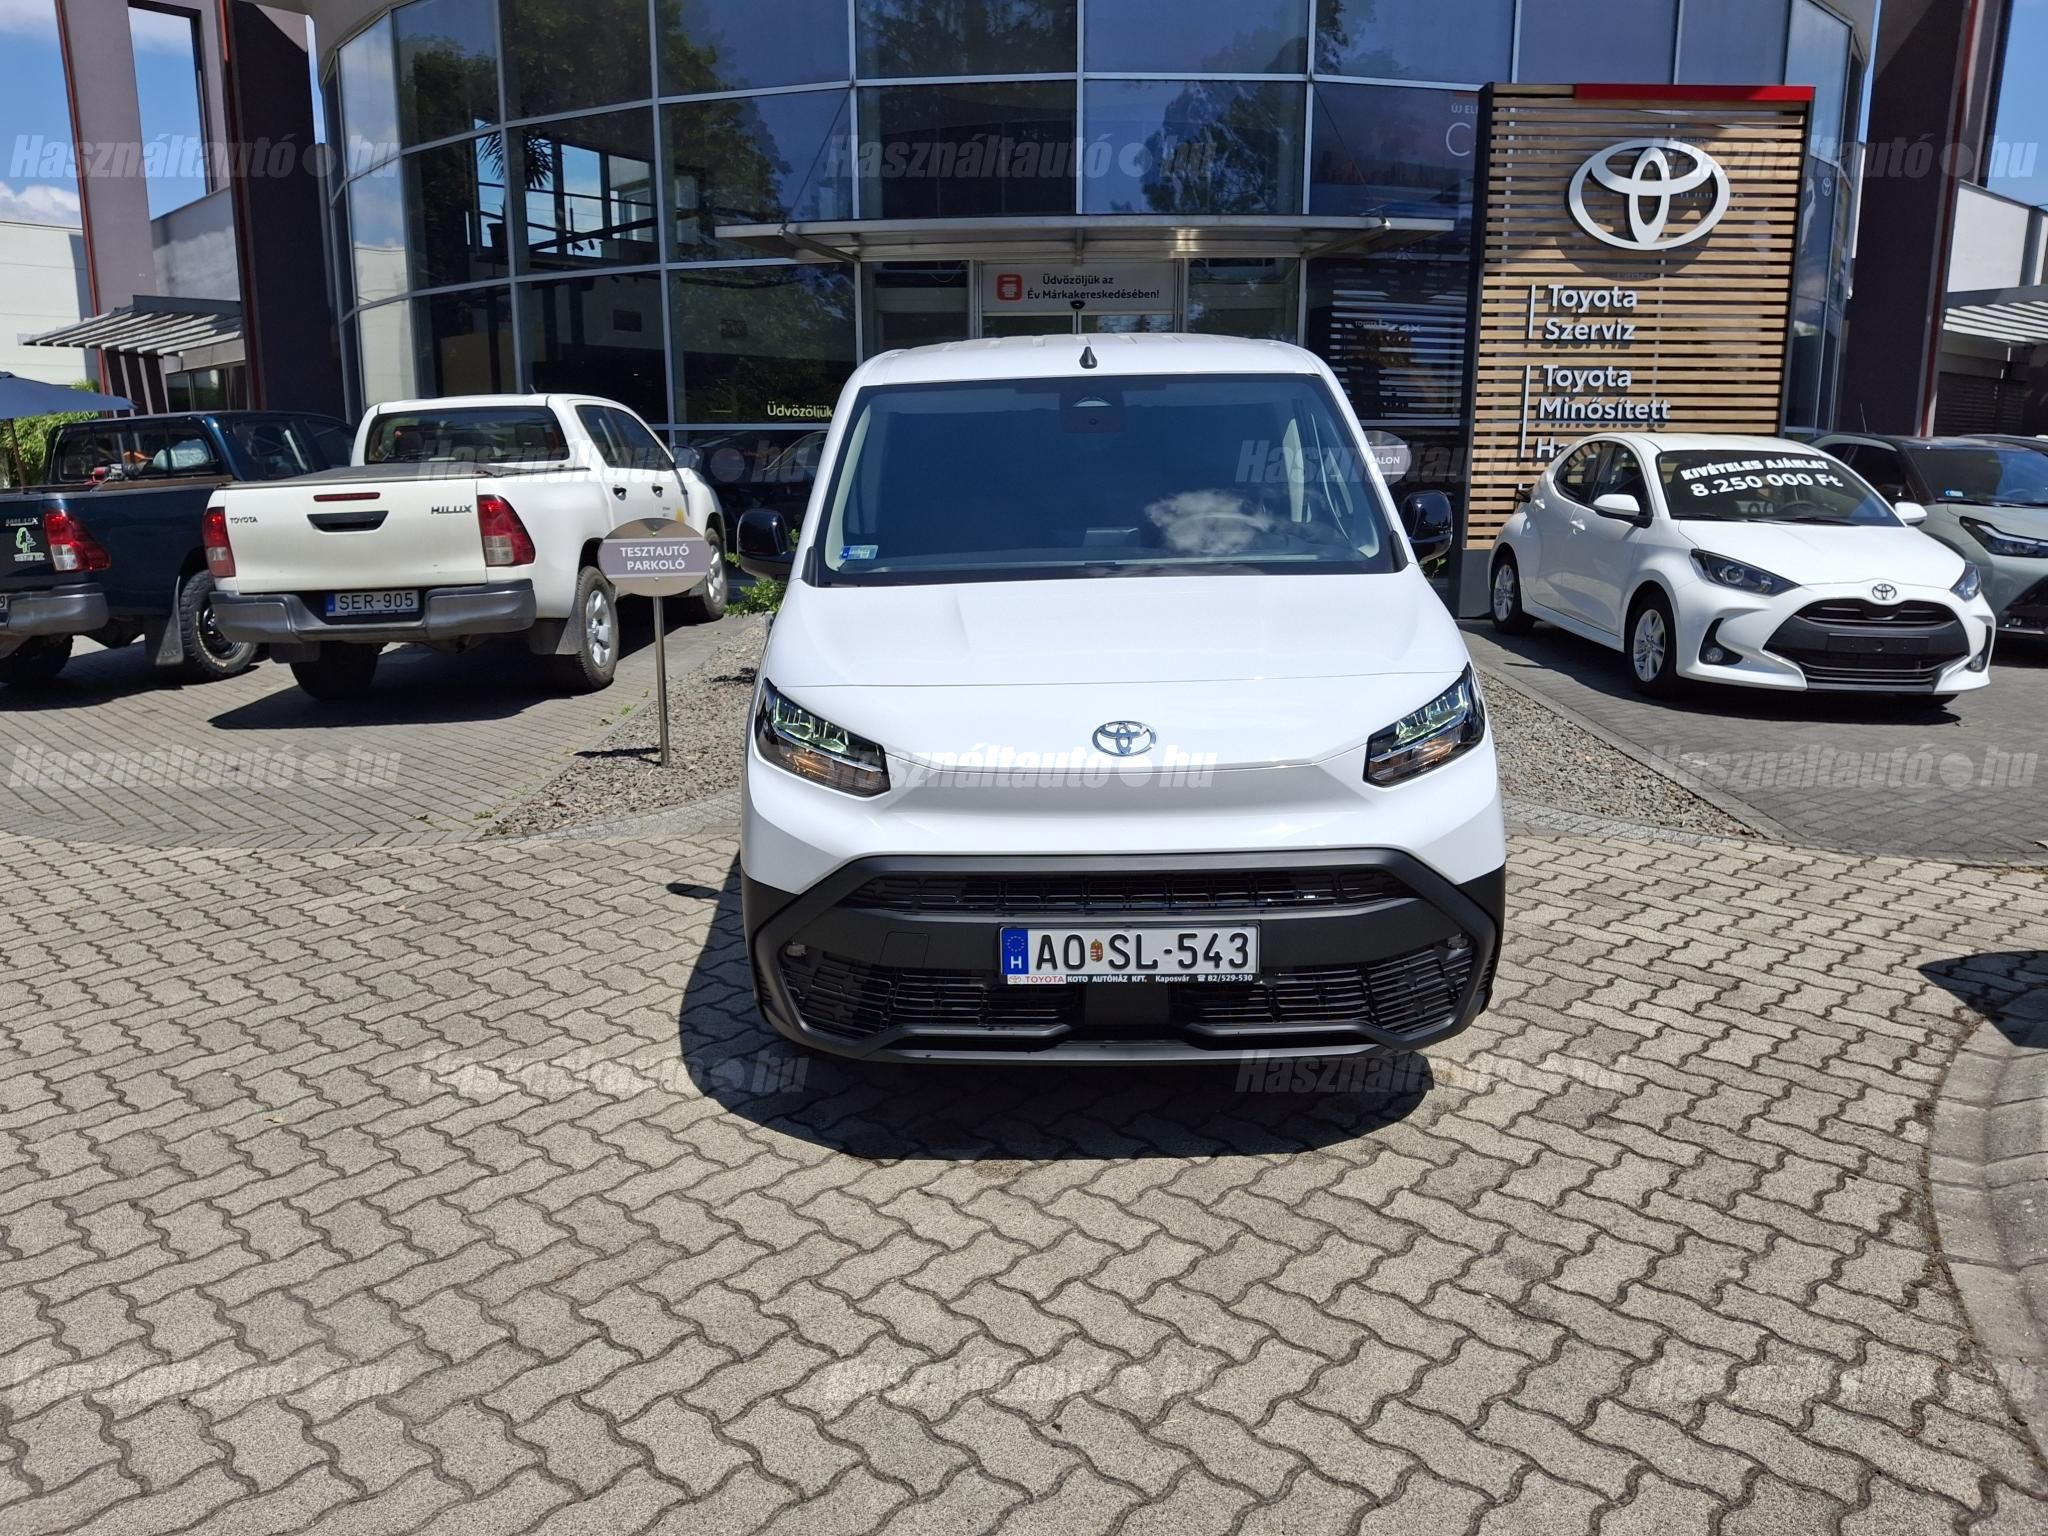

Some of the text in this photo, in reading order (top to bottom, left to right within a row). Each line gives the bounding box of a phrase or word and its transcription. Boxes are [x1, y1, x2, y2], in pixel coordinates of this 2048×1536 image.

[1042, 273, 1114, 287] Üdvözöljük az
[1027, 287, 1160, 299] Év Márkakereskedésében!
[1548, 284, 1638, 313] Toyota
[1545, 318, 1636, 340] Szerviz
[1543, 364, 1632, 393] Toyota
[767, 401, 833, 418] Üdvözöljük
[1539, 397, 1671, 420] Minősített
[1680, 457, 1830, 481] KIVÉTELES AJÁNLAT
[1690, 473, 1844, 497] 8.250 000 Ft
[431, 504, 473, 515] HILUX
[230, 516, 258, 524] TOYOTA
[620, 543, 690, 557] TESZTAUTÓ
[627, 557, 686, 571] PARKOLÓ
[339, 592, 414, 611] SER-905
[1010, 956, 1022, 968] H
[1025, 976, 1065, 984] TOYOTA
[1092, 974, 1128, 983] AUTÓHÁZ
[1155, 975, 1190, 984] Kaposvár
[1207, 974, 1253, 982] 82/529-530
